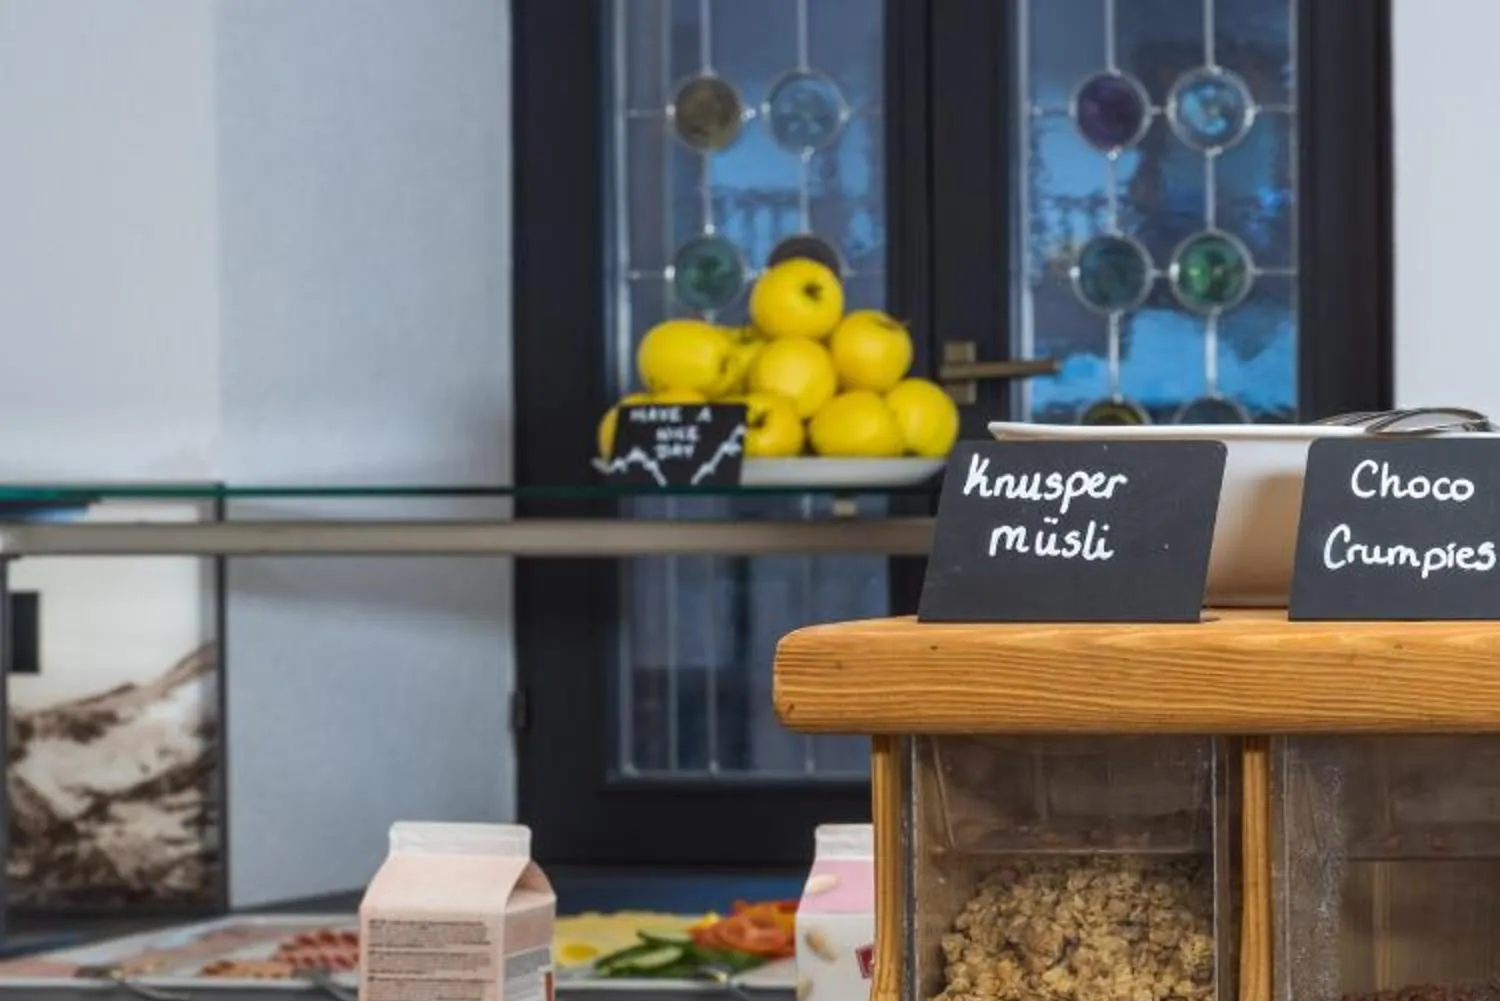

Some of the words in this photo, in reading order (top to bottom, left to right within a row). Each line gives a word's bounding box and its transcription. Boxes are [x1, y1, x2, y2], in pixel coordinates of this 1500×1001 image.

[697, 406, 712, 422] A
[963, 453, 1128, 514] Knusper
[1351, 459, 1475, 502] Choco
[988, 517, 1114, 561] müsli
[1323, 523, 1497, 579] Crumpies
